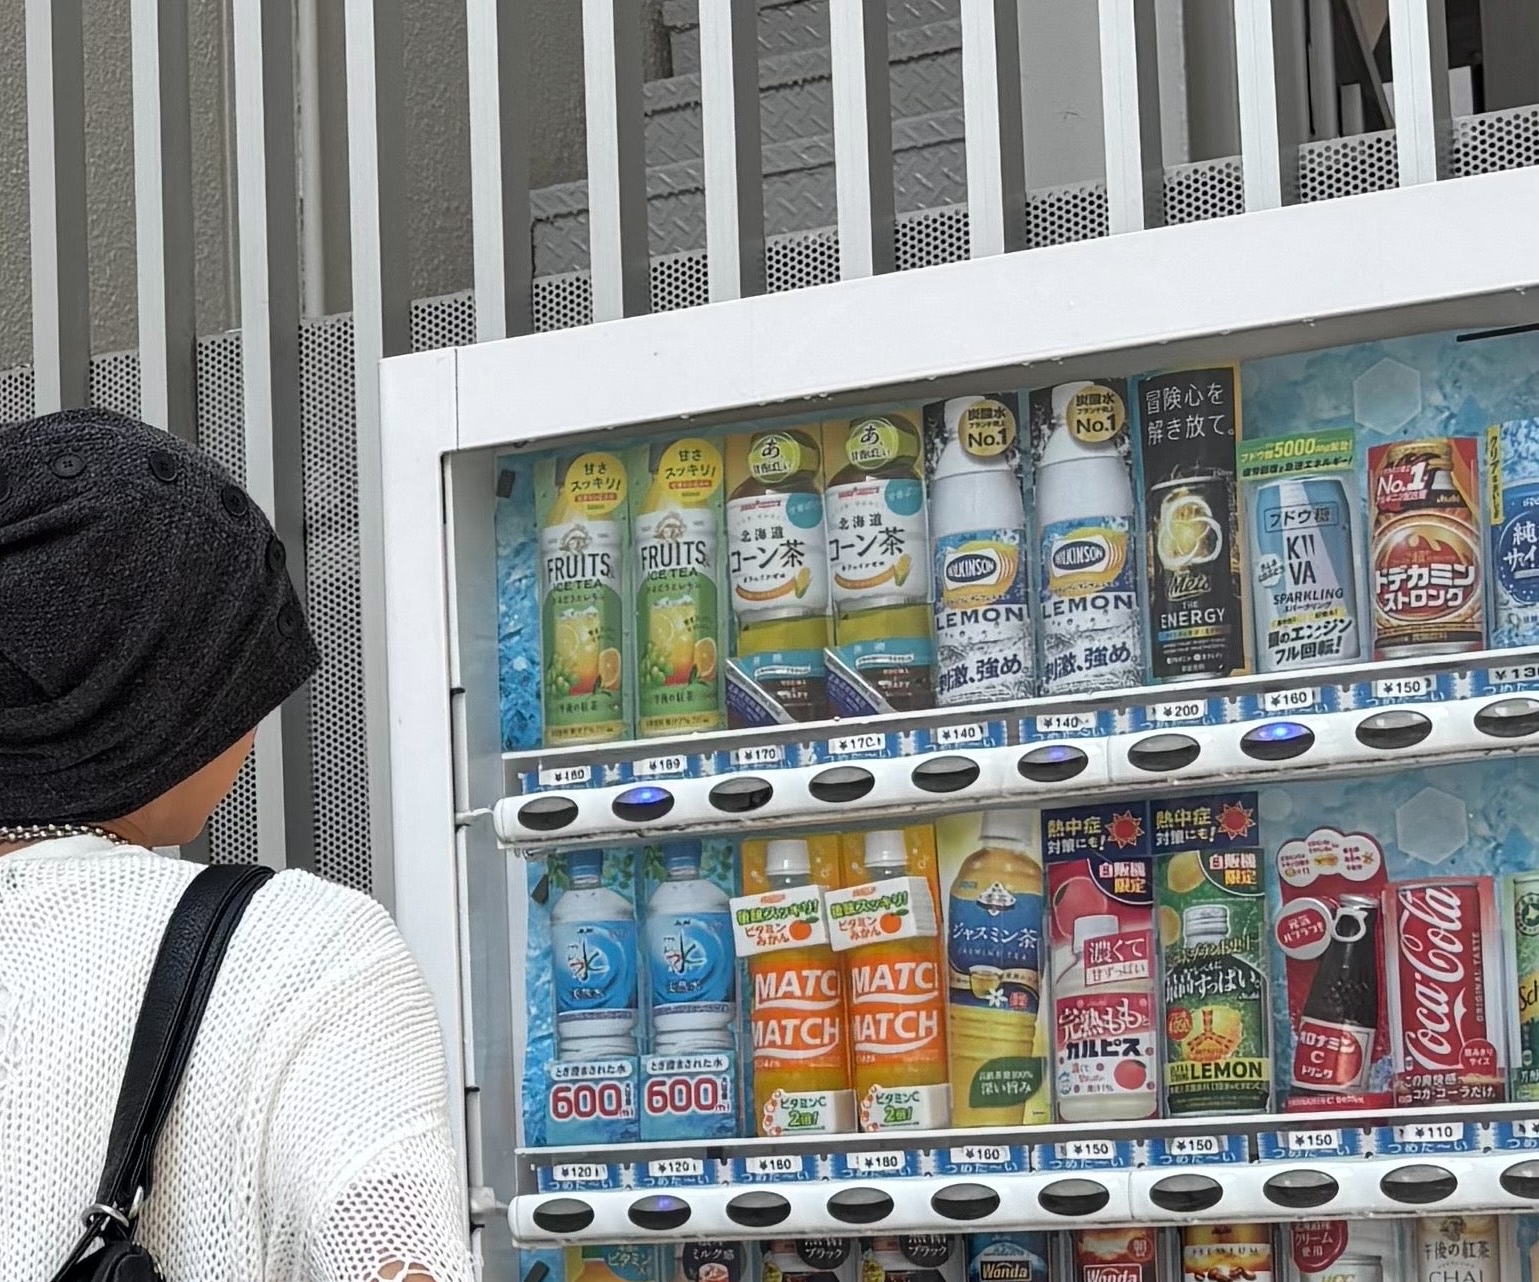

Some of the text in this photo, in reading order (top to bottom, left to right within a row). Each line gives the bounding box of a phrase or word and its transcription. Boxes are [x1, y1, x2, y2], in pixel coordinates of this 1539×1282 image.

[1145, 382, 1224, 415] 冒険心を
[1076, 414, 1116, 434] No.1
[1148, 413, 1235, 445] 解き放て。
[968, 428, 1007, 448] No.1
[679, 449, 702, 462] 甘さ
[584, 462, 607, 475] 甘さ
[1377, 462, 1427, 495] No.1
[839, 513, 883, 530] 北海道
[741, 527, 784, 542] 北海道
[829, 527, 905, 562] コーン茶
[641, 541, 707, 571] FRUITS
[732, 540, 806, 573] コーン茶
[547, 553, 611, 583] FRUITS
[671, 567, 698, 579] TEA
[1376, 563, 1474, 593] ドデカミン
[575, 578, 603, 590] TEA
[1042, 594, 1133, 620] LEMON
[1273, 588, 1344, 606] SPARKLING
[1384, 588, 1464, 612] ストロング
[936, 606, 1024, 631] LEMON
[1161, 608, 1225, 629] ENERGY
[1275, 636, 1342, 665] フル回転!
[1047, 816, 1102, 837] 熱中症
[1156, 808, 1211, 829] 熱中症
[1114, 878, 1146, 894] 限定
[1224, 869, 1257, 885] 限定
[953, 922, 1037, 948] ジャスミン茶
[1089, 939, 1145, 964] 濃くて
[755, 970, 840, 1003] MATC
[852, 962, 938, 1002] MATC
[1065, 1038, 1141, 1060] カルピス
[1311, 1051, 1324, 1064] C
[1190, 1062, 1263, 1080] LEMON
[1301, 1065, 1334, 1079] ドリンク
[1295, 1232, 1333, 1246] クリーム
[1425, 1241, 1490, 1259] 午後の紅茶
[982, 1262, 1028, 1279] Wonda
